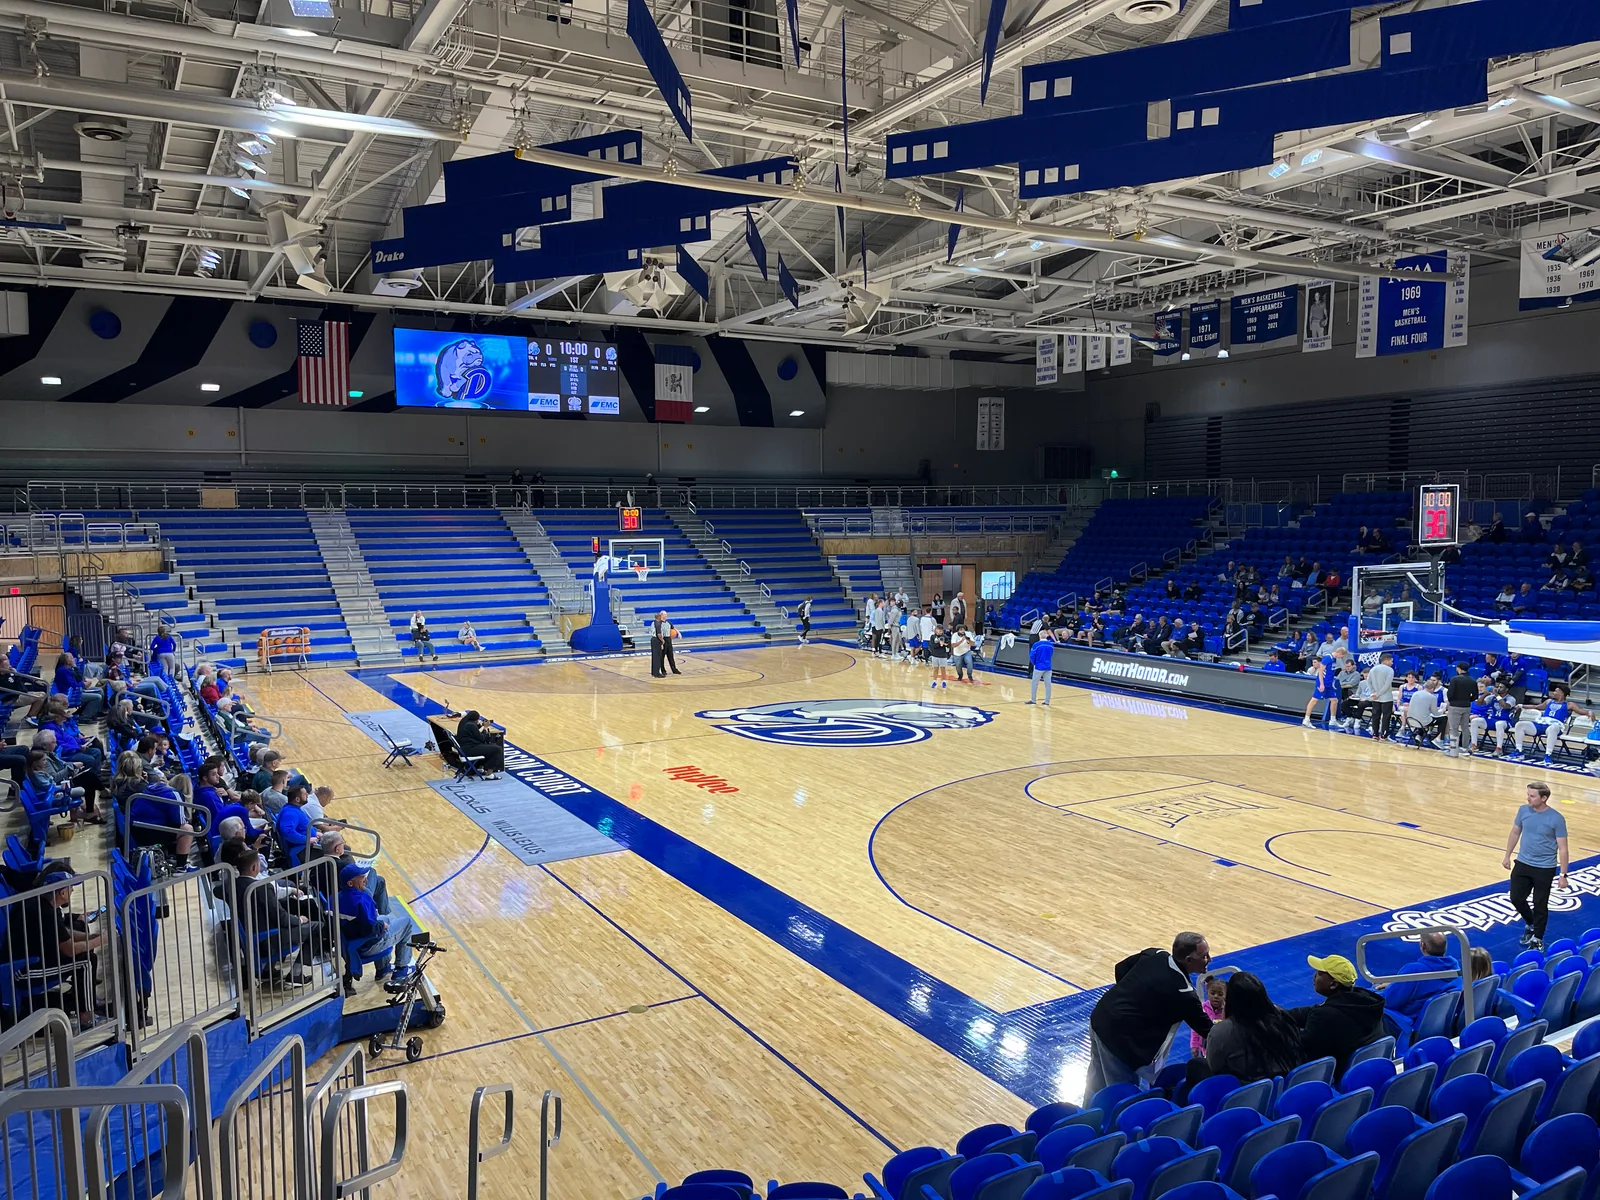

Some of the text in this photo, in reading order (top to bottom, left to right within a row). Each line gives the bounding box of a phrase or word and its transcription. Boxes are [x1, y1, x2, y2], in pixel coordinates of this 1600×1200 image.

[375, 250, 405, 263] Drake
[1547, 264, 1562, 272] 1935
[1579, 269, 1595, 278] 1969
[1546, 275, 1562, 283] 1936
[1578, 280, 1594, 289] 1970
[1401, 285, 1421, 300] 1969
[1546, 286, 1561, 294] 1939
[1241, 291, 1286, 305] MEN'S BASKETBALL
[1250, 302, 1283, 314] APPEARANCES
[1403, 307, 1420, 317] MEN'S
[1267, 321, 1278, 330] 2021
[1394, 316, 1427, 328] BASKETBALL
[1198, 324, 1211, 334] 1971
[1191, 333, 1218, 343] ELITE EIGHT
[1391, 332, 1428, 347] FINAL FOUR
[546, 344, 552, 355] 0
[560, 342, 588, 356] 10:00
[595, 347, 601, 359] 0
[1037, 373, 1056, 382] CHAMPIONS
[623, 509, 639, 517] 10:00
[624, 516, 637, 529] 30
[1425, 509, 1447, 538] 30
[516, 769, 592, 797] COURT
[453, 790, 492, 815] LEXUS
[491, 819, 546, 855] WILLIS LEXUS
